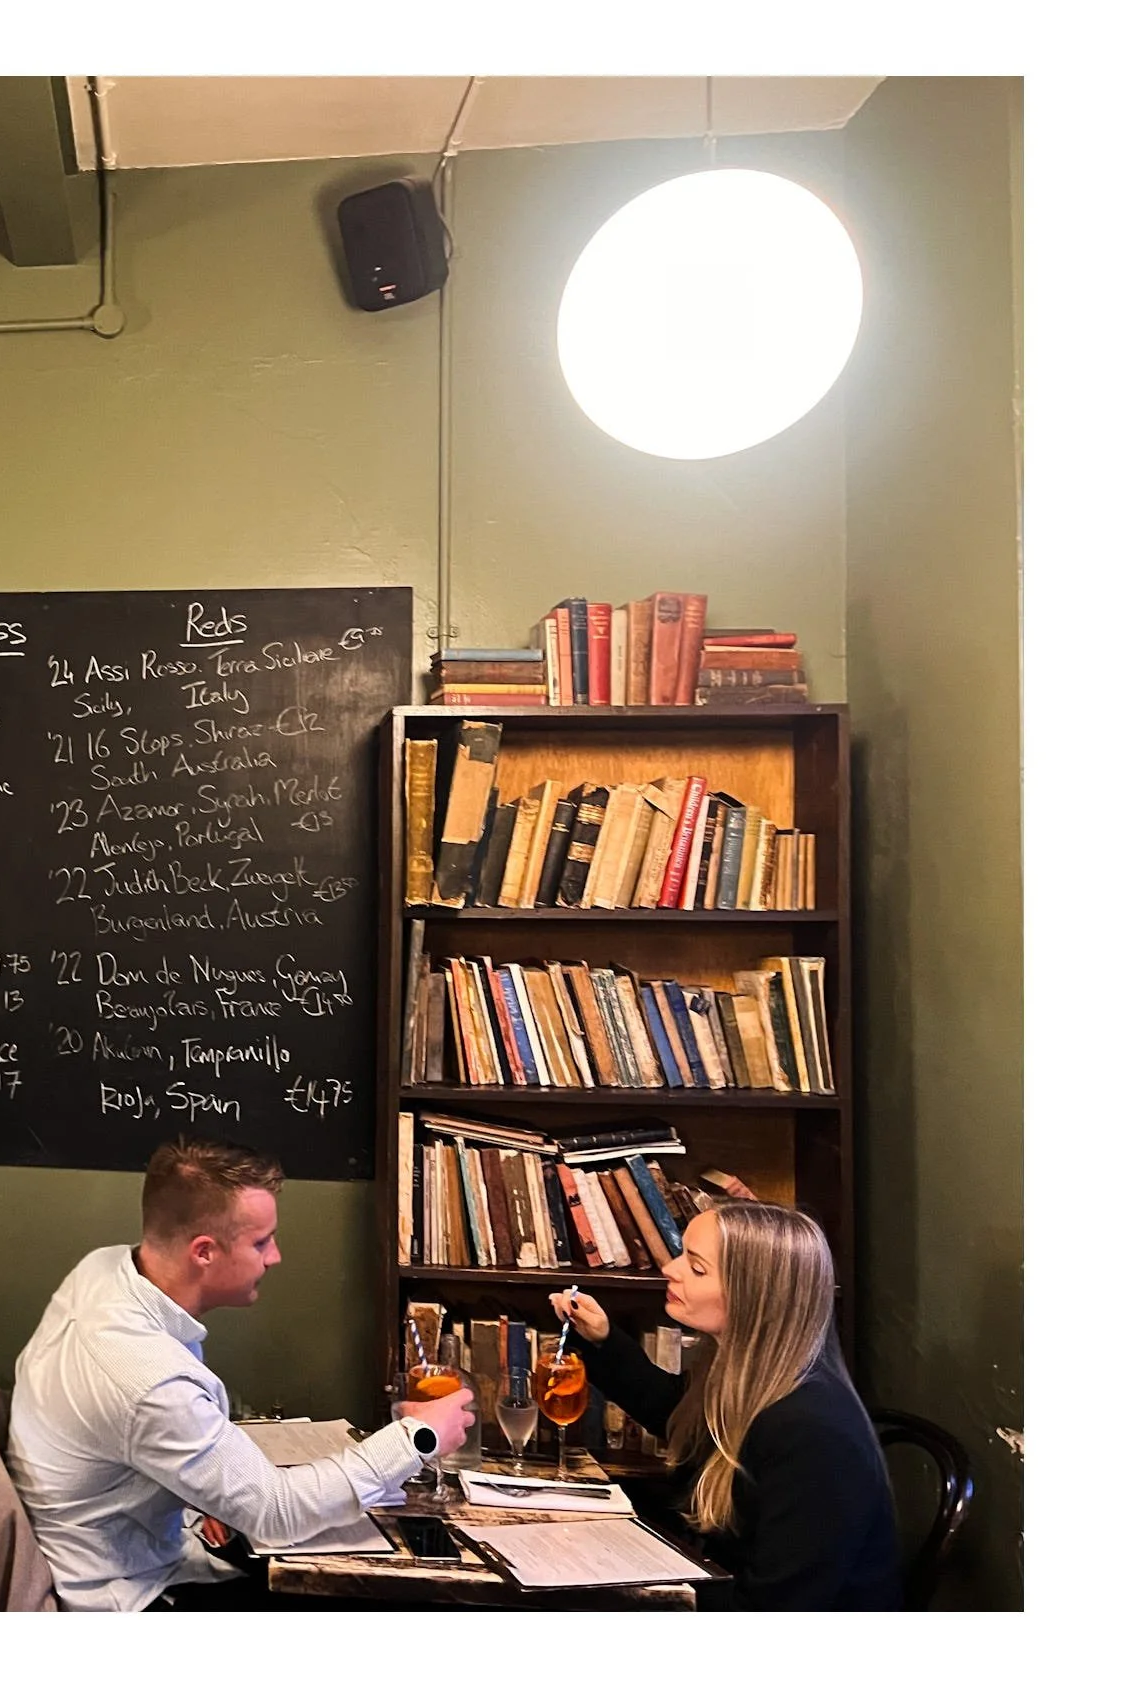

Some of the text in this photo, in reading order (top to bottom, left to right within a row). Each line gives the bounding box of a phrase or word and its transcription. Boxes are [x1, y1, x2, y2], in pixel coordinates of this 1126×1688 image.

[186, 602, 248, 643] Reds
[85, 655, 130, 685] Assi
[181, 680, 250, 715] Italy
[87, 728, 111, 760] 16
[90, 746, 276, 791] South Australia
[51, 798, 89, 834] '23
[273, 776, 344, 807] Merlot
[174, 817, 265, 850] Portugal
[49, 868, 91, 904] '22
[93, 862, 169, 896] Judith
[226, 898, 323, 932] Austria
[51, 949, 82, 986] '22
[155, 955, 183, 986] de
[4, 990, 24, 1013] 13
[215, 988, 282, 1019] France
[165, 1081, 241, 1122] Spain
